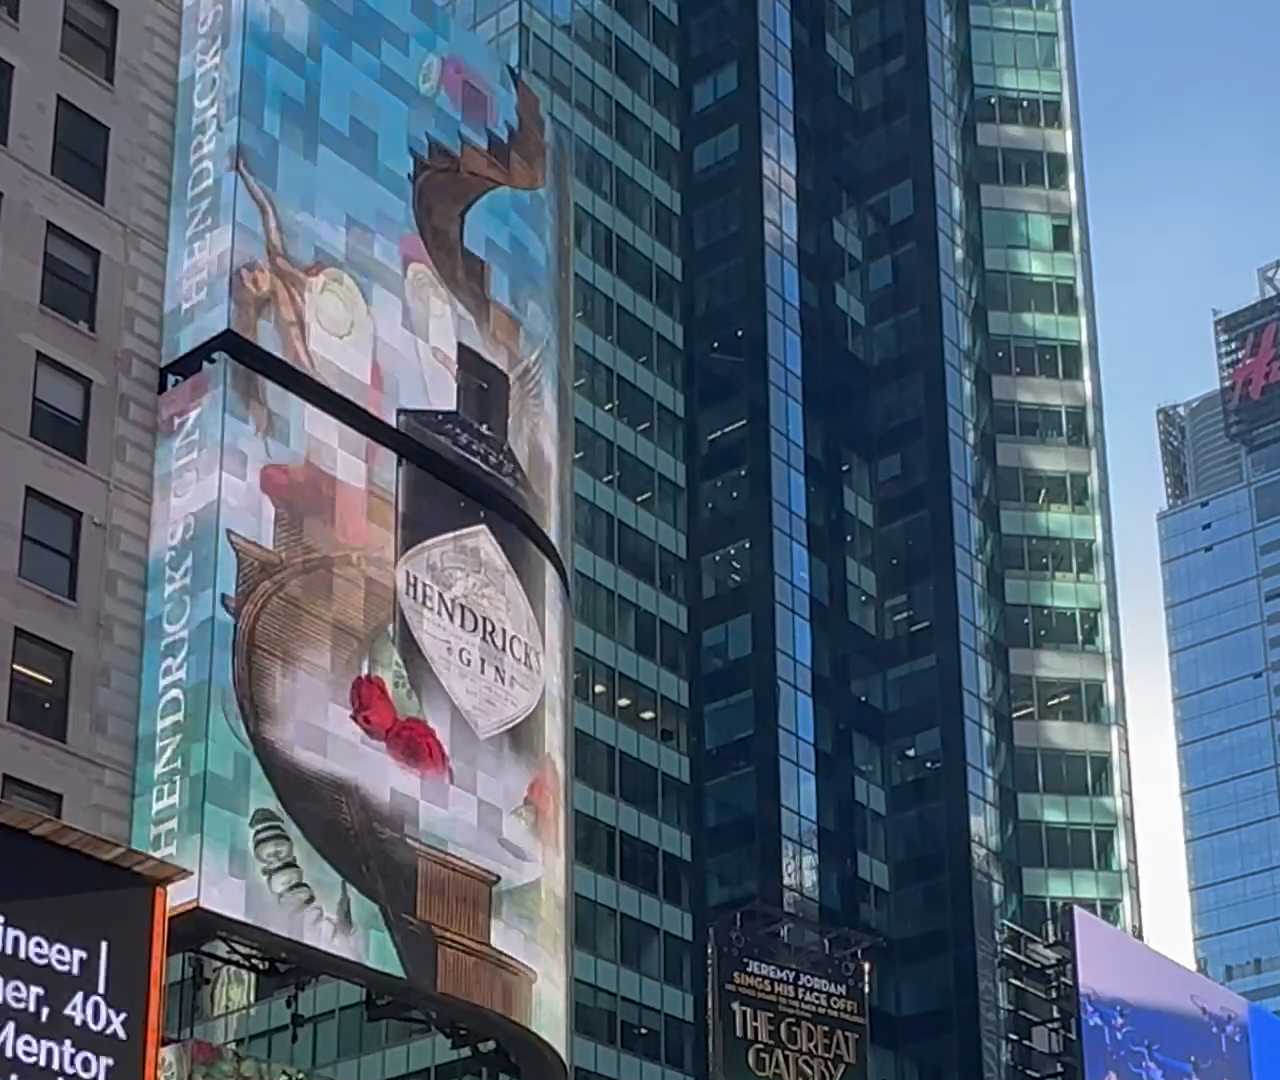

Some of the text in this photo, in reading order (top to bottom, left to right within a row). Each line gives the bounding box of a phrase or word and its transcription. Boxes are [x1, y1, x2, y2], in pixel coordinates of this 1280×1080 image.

[149, 510, 197, 858] HENDRICK'S
[459, 647, 506, 687] GIN
[733, 971, 772, 992] SINGS
[773, 983, 795, 998] HIS
[798, 989, 827, 1006] FACE
[798, 973, 846, 997] JORDAN
[63, 991, 128, 1041] 40x
[730, 1000, 859, 1064] THE GREAT
